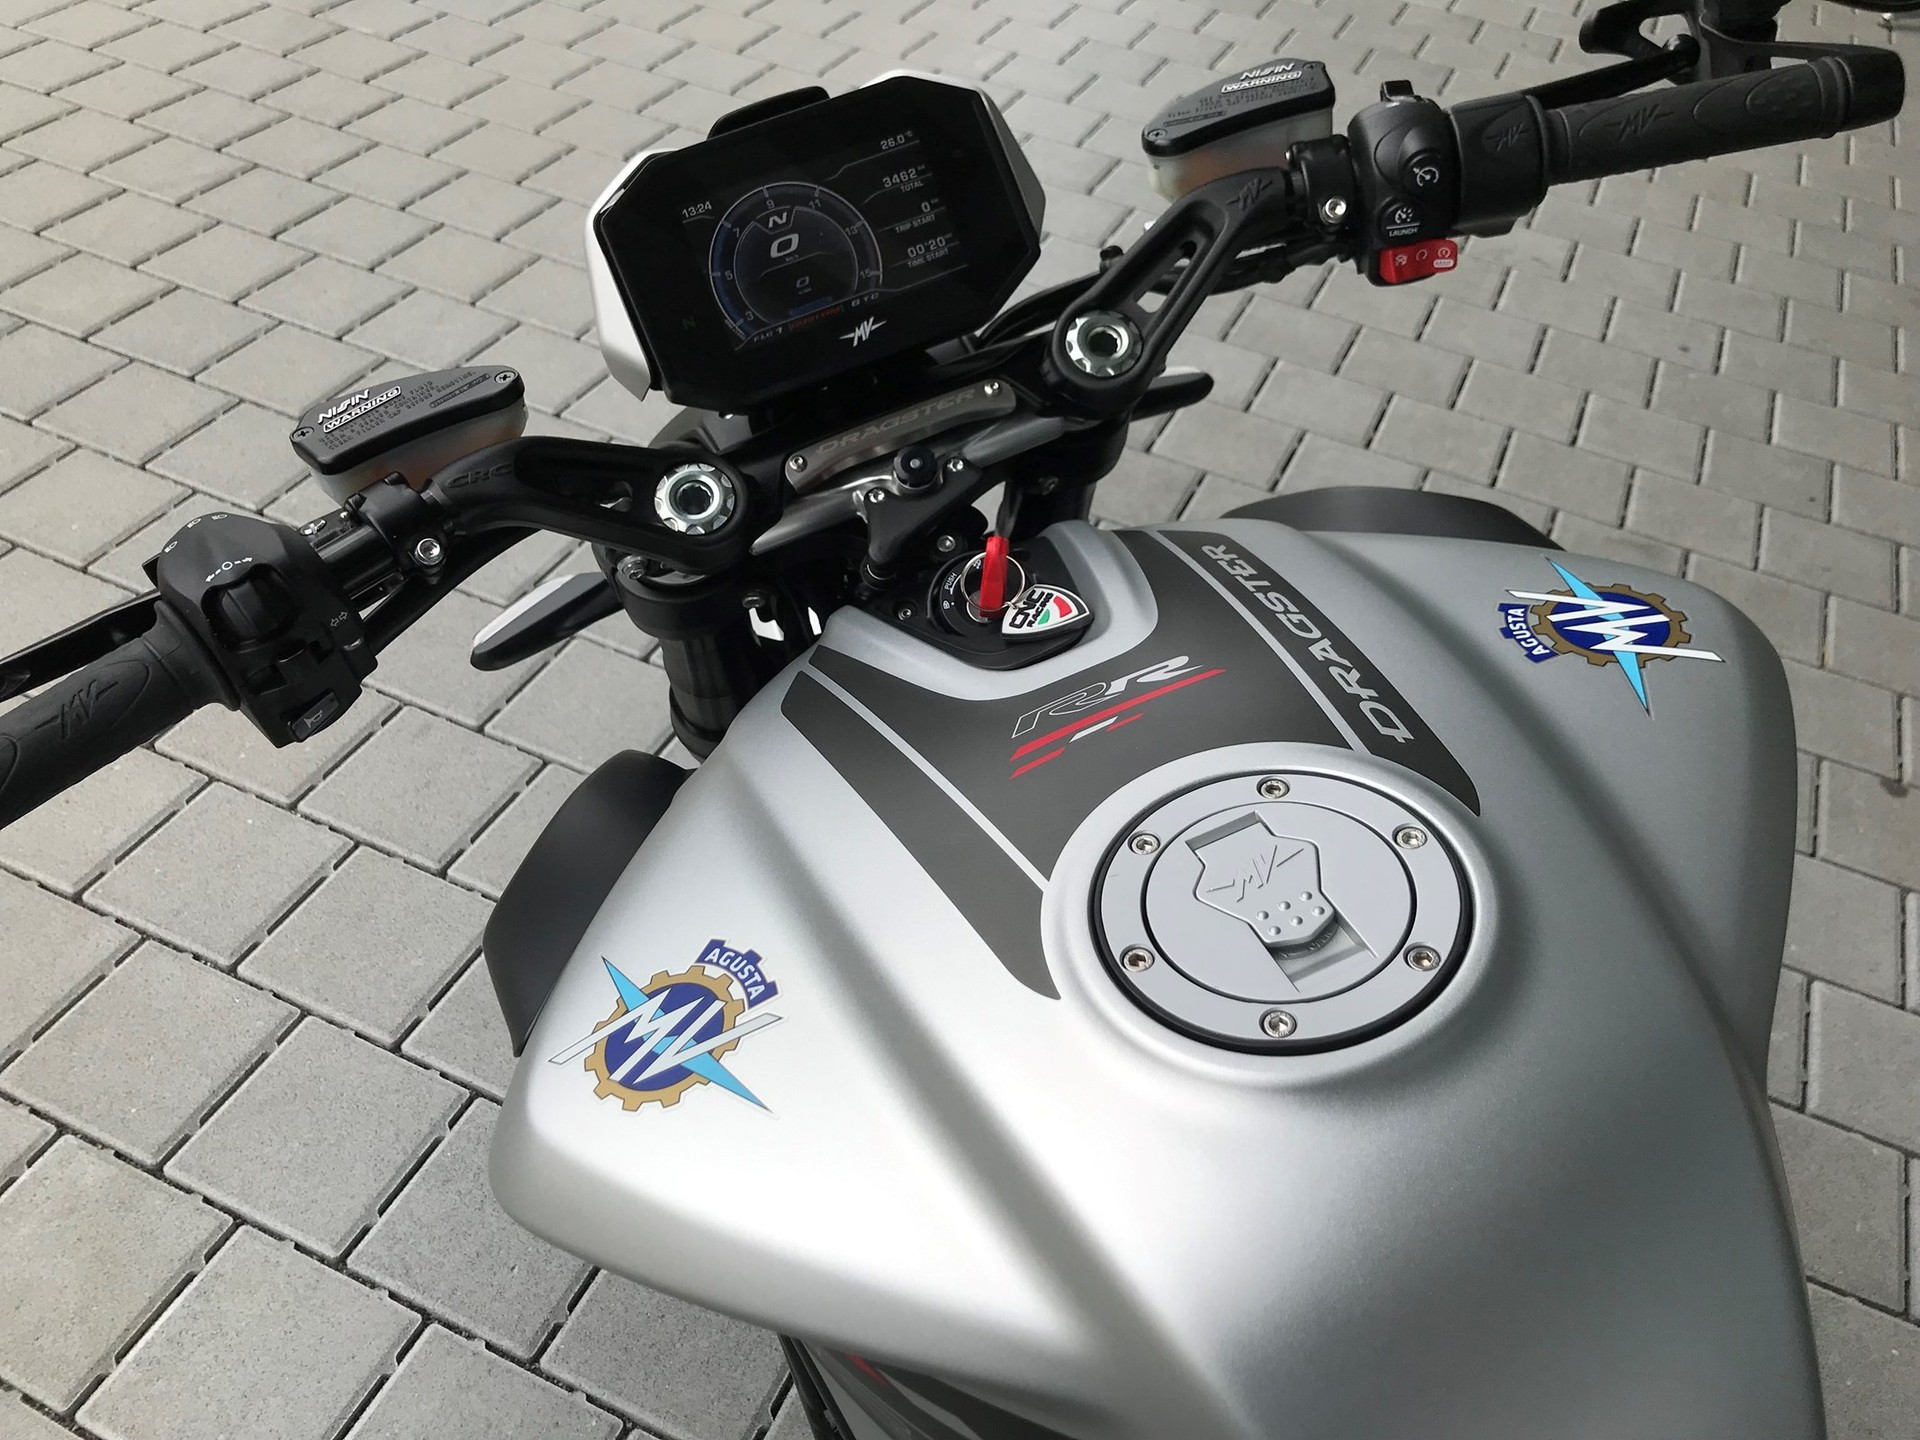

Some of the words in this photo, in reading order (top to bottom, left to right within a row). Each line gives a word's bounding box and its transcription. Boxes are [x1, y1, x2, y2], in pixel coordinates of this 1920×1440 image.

[882, 168, 918, 188] 3462
[900, 181, 924, 193] TOTAL
[682, 201, 712, 218] 13:24
[921, 202, 931, 213] 0
[768, 212, 788, 228] N
[1388, 227, 1418, 237] LAUNCH
[770, 234, 799, 258] 0
[326, 388, 399, 430] WARNING
[816, 388, 976, 453] DRAGSTER
[944, 572, 957, 590] PUSH
[1507, 607, 1551, 656] AGUSTA
[1201, 545, 1415, 744] DRAGSTER
[704, 947, 766, 1001] AGUSTA
